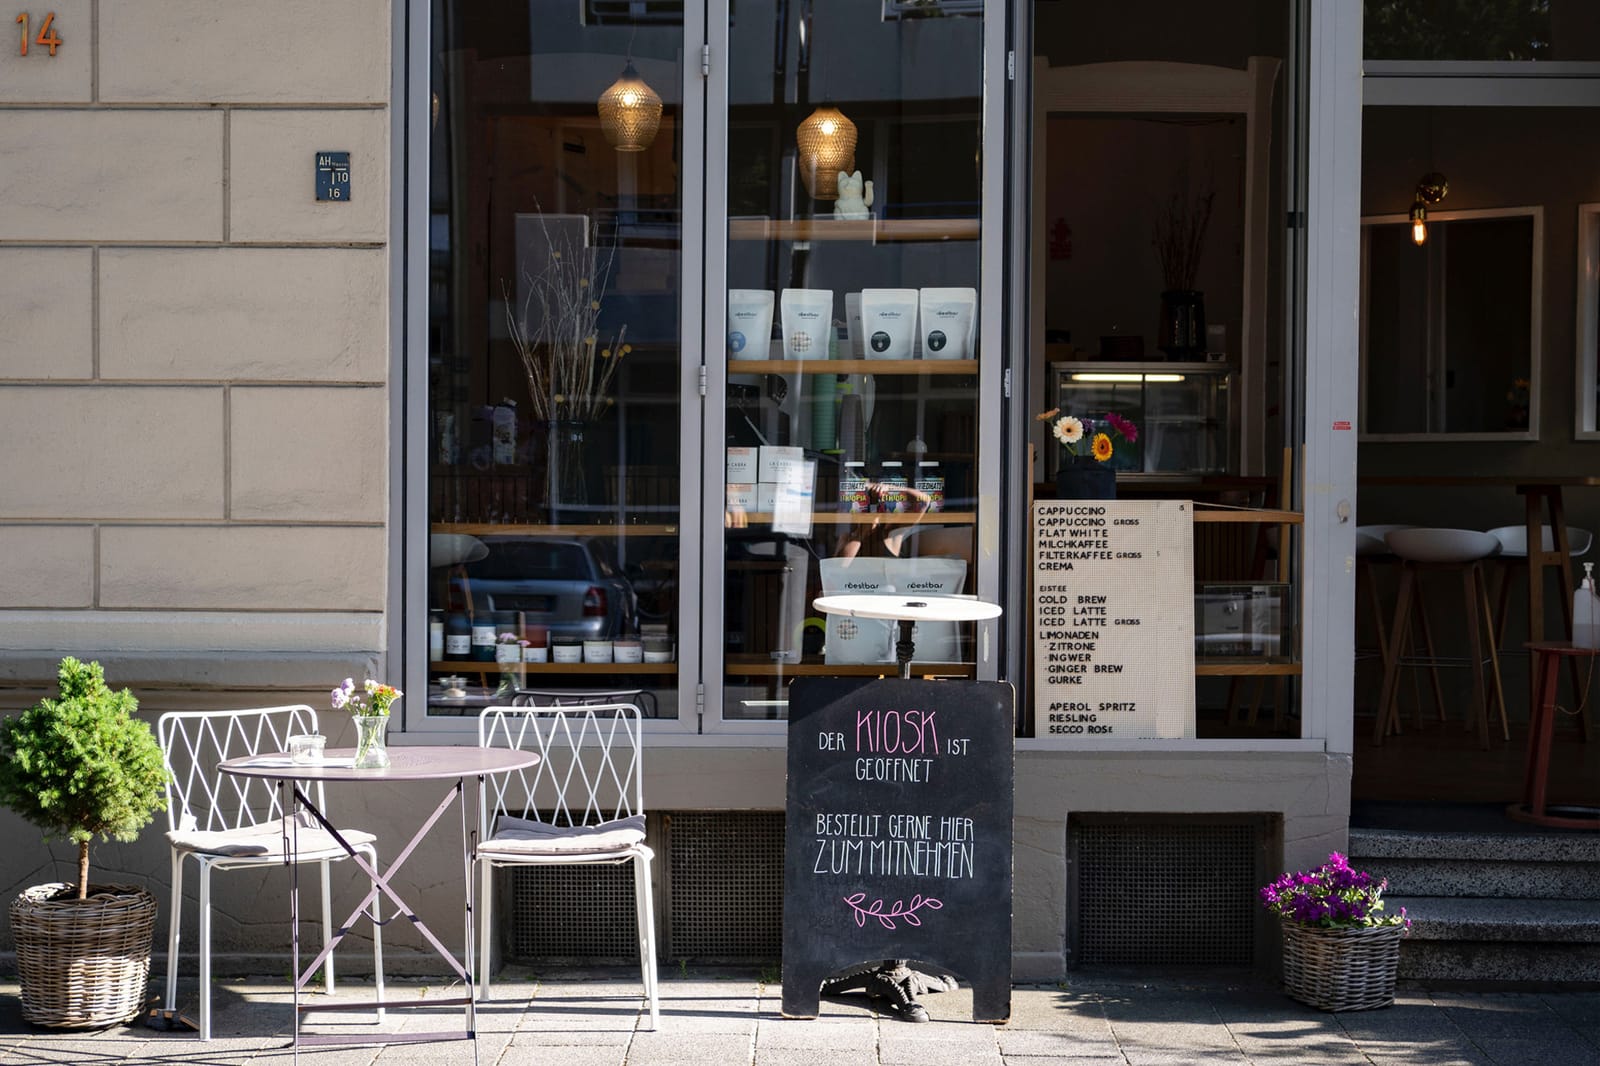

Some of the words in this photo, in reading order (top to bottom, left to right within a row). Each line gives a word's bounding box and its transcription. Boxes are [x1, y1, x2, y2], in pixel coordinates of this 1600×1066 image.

[16, 12, 63, 57] 14
[319, 156, 331, 166] AH
[329, 188, 341, 198] 16
[1038, 507, 1106, 515] CAPPUCCINO
[1038, 518, 1106, 526] CAPPUCCINO
[1039, 529, 1066, 537] FLAT
[1070, 529, 1109, 537] WHITE
[1039, 540, 1109, 549] MILCHKAFFEE
[1039, 551, 1113, 560] FILTERKAFFEE
[1038, 562, 1074, 571] CREMA
[1039, 595, 1068, 604] COLD
[1078, 595, 1107, 604] BREW
[1039, 606, 1066, 615] ICED
[1073, 606, 1107, 615] LATTE
[1039, 618, 1066, 626] ICED
[1073, 618, 1107, 626] LATTE
[1040, 631, 1099, 640] LIMONADEN
[1094, 664, 1123, 673] BREW
[1048, 676, 1082, 684] GURKE
[1049, 702, 1092, 711] APEROL
[1098, 702, 1136, 711] SPRITZ
[1049, 714, 1097, 722] RIESLING
[818, 732, 846, 751] DER
[856, 710, 939, 755] KIOSK
[947, 738, 971, 756] IST
[1049, 725, 1084, 734] SECCO
[1087, 725, 1113, 734] ROSE
[816, 813, 882, 837] BESTELLT
[888, 814, 933, 840] GERNE
[940, 816, 974, 842] HIER
[813, 839, 864, 875] ZUM
[870, 839, 974, 879] MITNEHMEN
